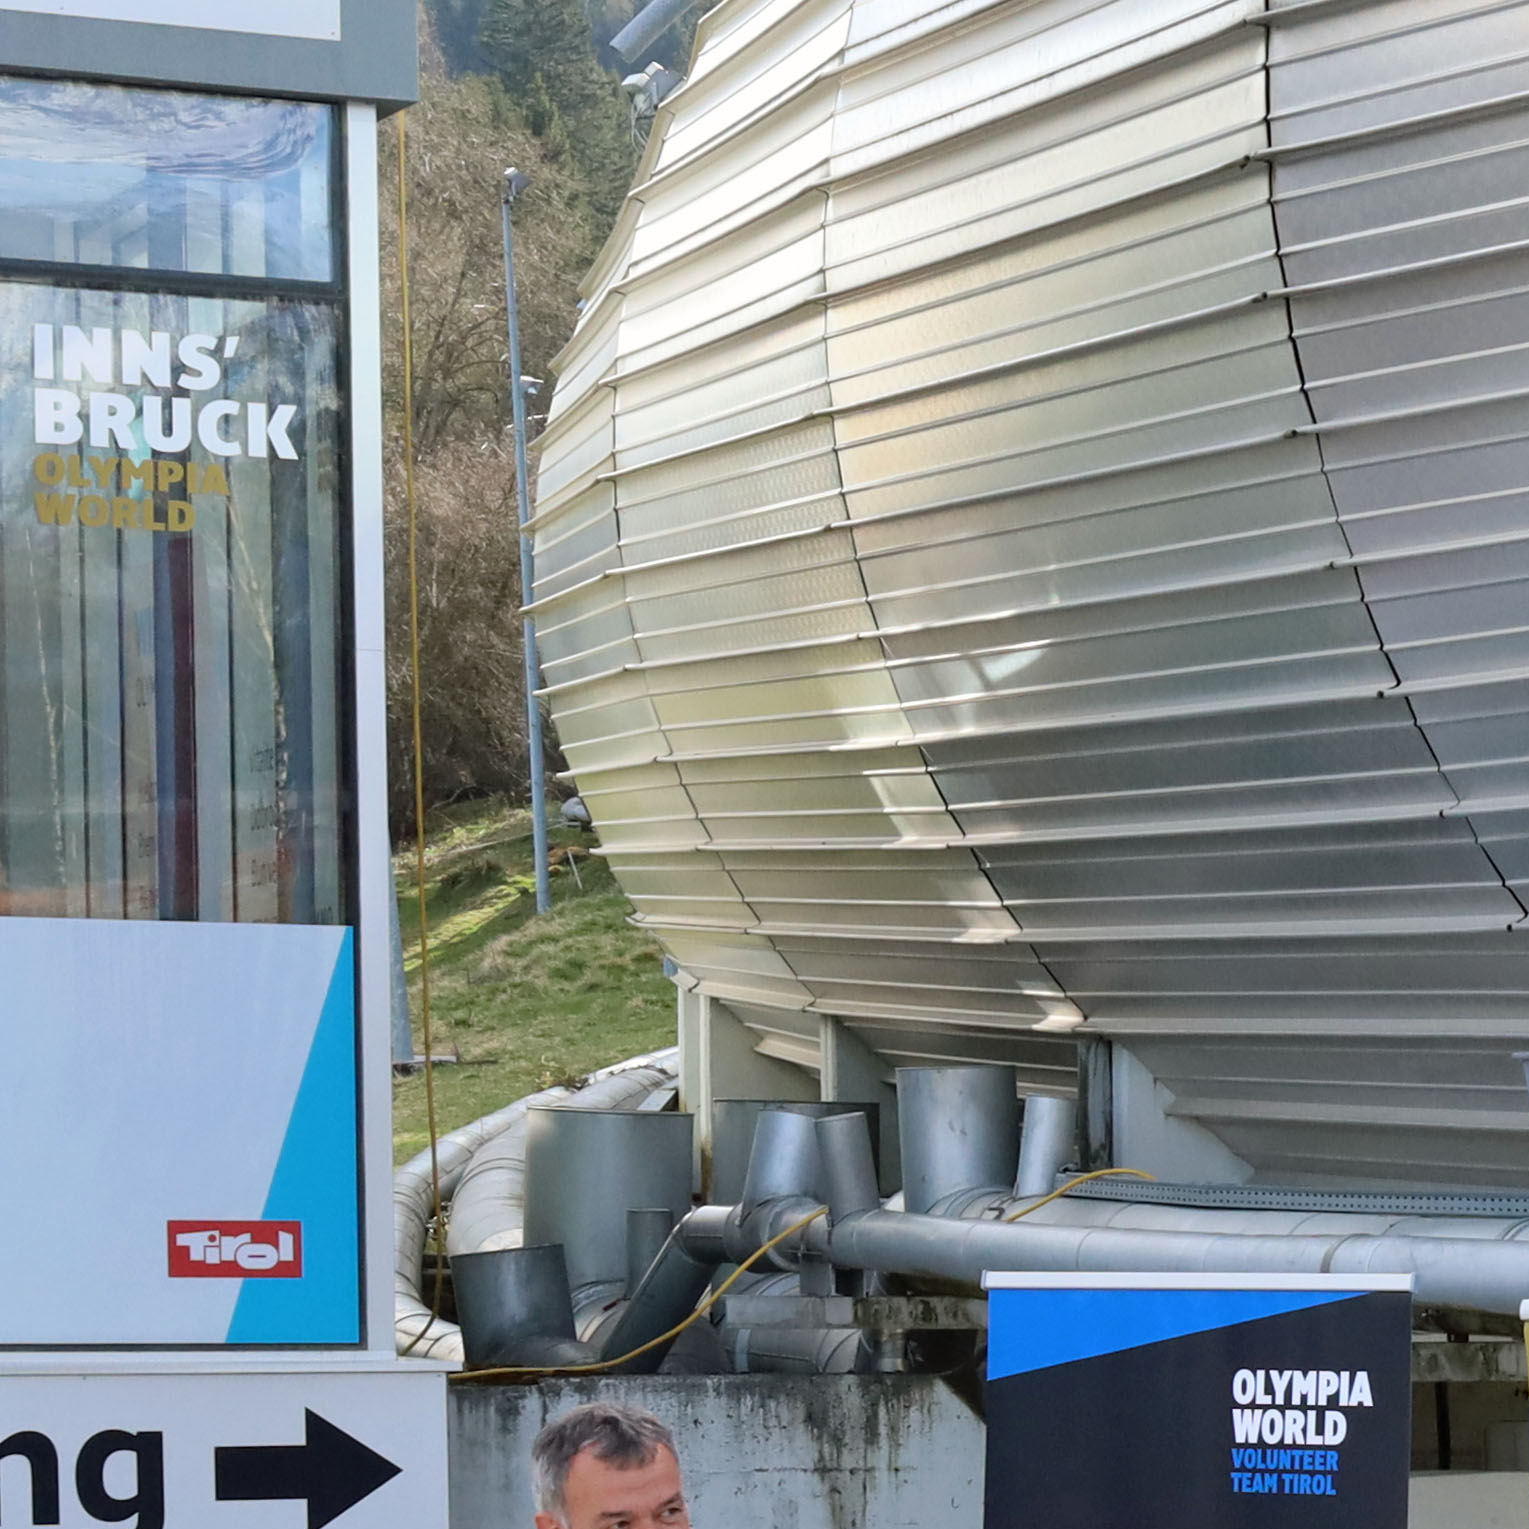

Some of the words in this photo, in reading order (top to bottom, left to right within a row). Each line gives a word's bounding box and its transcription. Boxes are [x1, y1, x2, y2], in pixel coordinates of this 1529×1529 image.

[33, 323, 240, 391] INNS'
[34, 387, 299, 460] BRUCK
[34, 452, 230, 497] OLYMPIA
[35, 493, 196, 532] WORLD
[175, 1229, 294, 1270] Tirol
[1232, 1368, 1373, 1407] OLYMPIA
[1232, 1408, 1347, 1446] WORLD
[1231, 1448, 1339, 1471] VOLUNTEER
[1230, 1472, 1278, 1494] TEAM
[1282, 1473, 1336, 1495] TIROL
